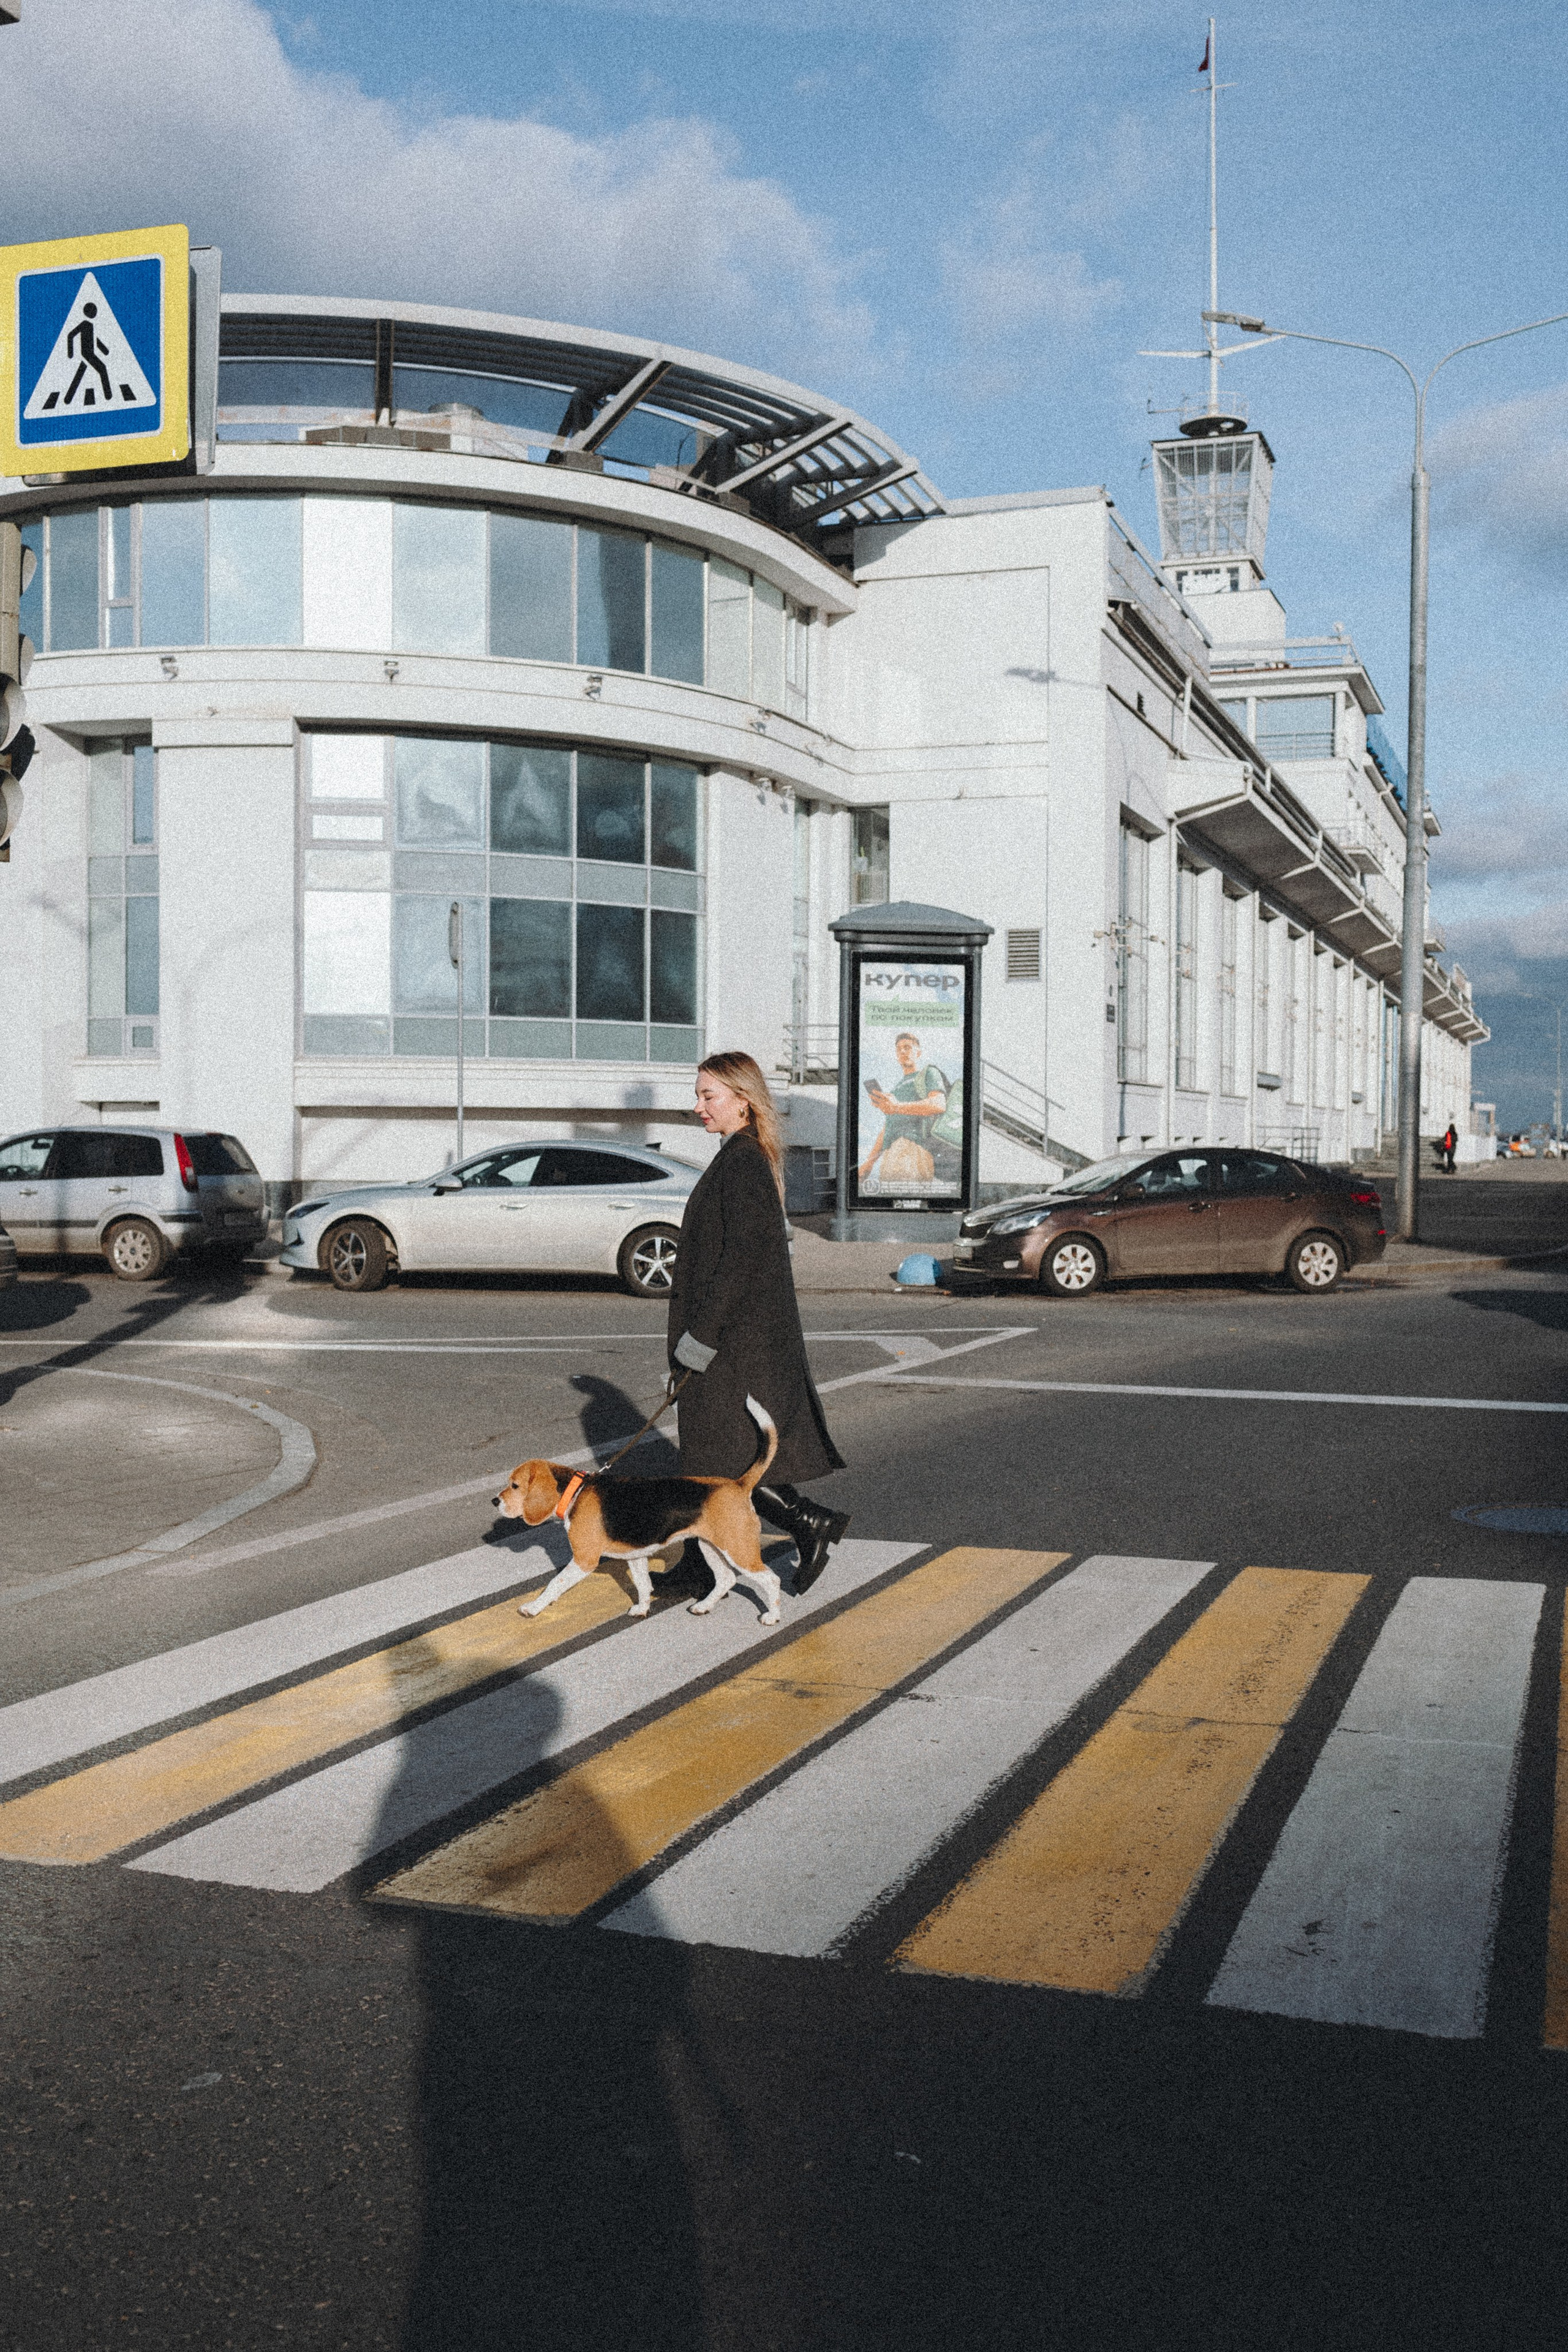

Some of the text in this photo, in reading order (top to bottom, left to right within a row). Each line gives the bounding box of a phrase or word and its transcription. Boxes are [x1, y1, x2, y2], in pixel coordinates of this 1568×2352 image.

[865, 973, 960, 991] купер
[871, 1005, 900, 1014] Твой
[891, 1014, 954, 1023] покупкам
